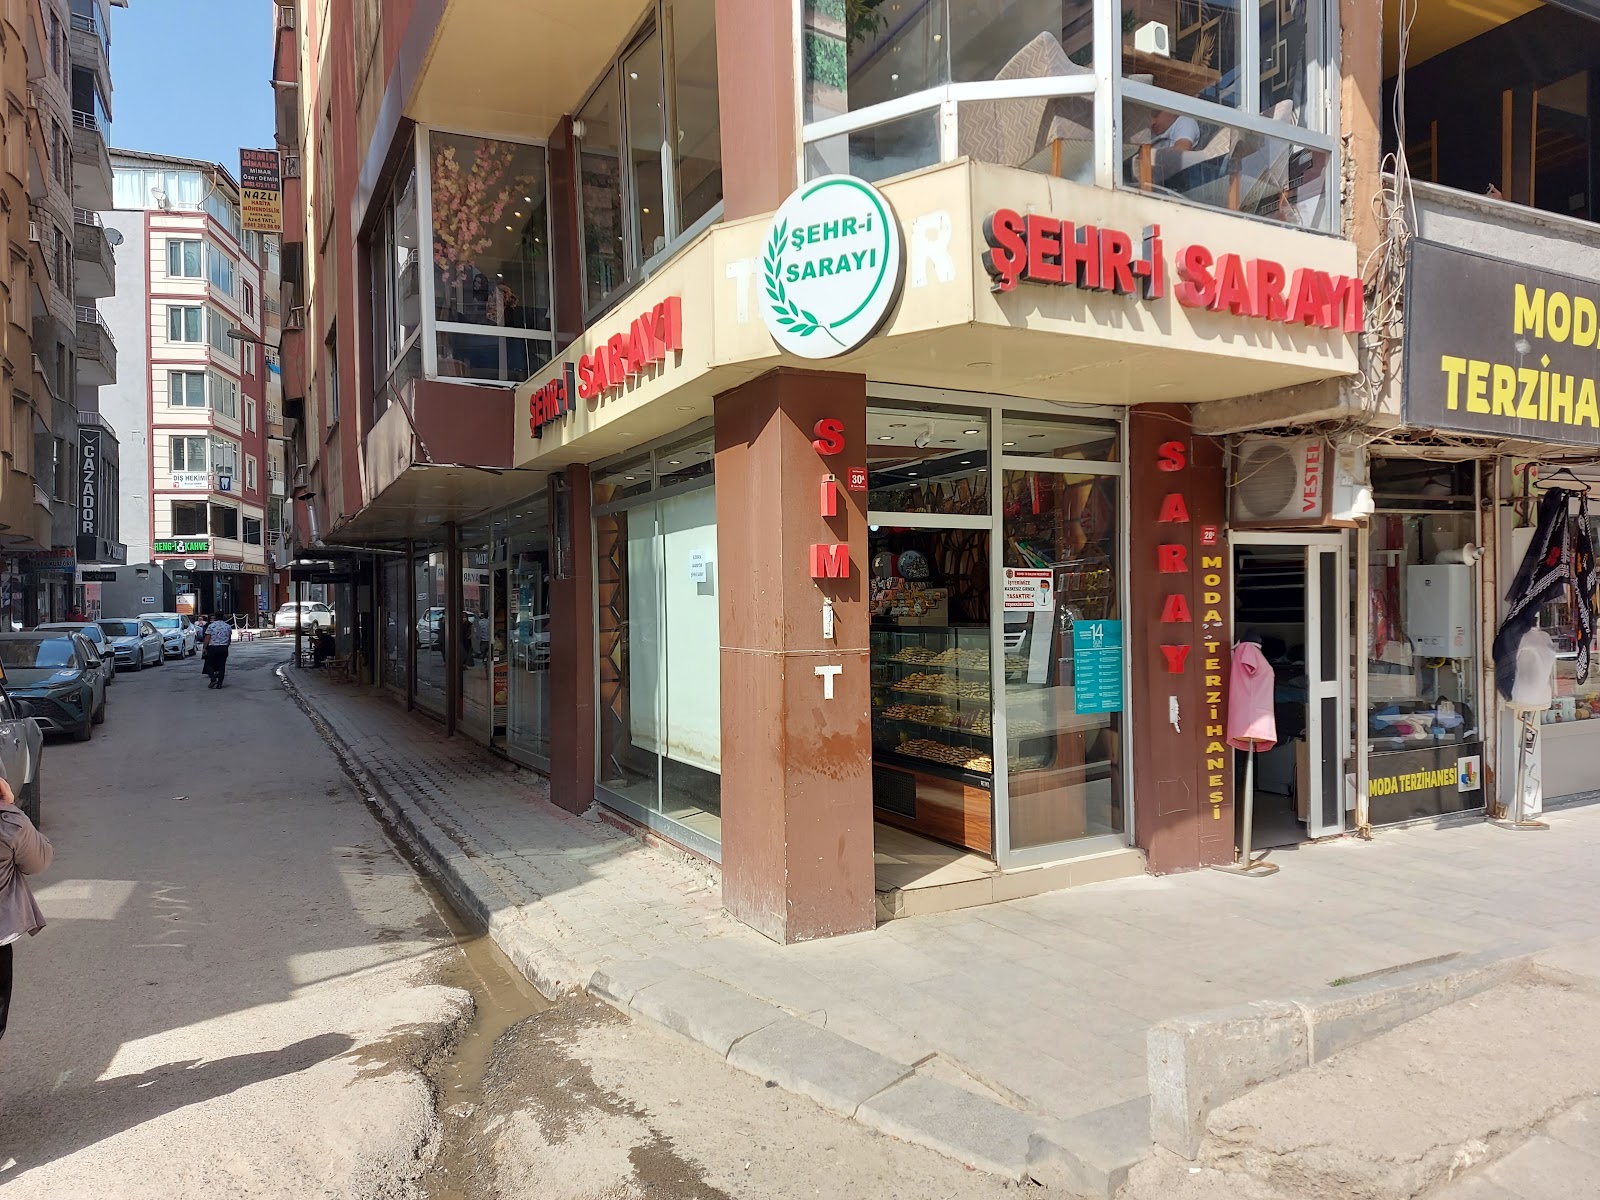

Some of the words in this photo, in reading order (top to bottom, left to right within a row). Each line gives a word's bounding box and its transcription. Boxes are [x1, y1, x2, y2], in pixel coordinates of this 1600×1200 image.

[244, 190, 277, 201] NAZLI
[786, 248, 876, 283] SARAYI
[1175, 244, 1364, 334] SARAYI
[578, 296, 683, 399] SARAYI
[1514, 283, 1600, 350] MOD
[82, 445, 95, 534] CAZADOR
[1302, 440, 1322, 512] VESTEL
[185, 542, 208, 551] KAHVE
[1202, 556, 1222, 622] MODA
[1090, 624, 1104, 640] 14
[1204, 641, 1225, 820] TERZİHANESİ
[1369, 776, 1398, 798] MODA
[1400, 762, 1458, 793] TERZİHANESİ
